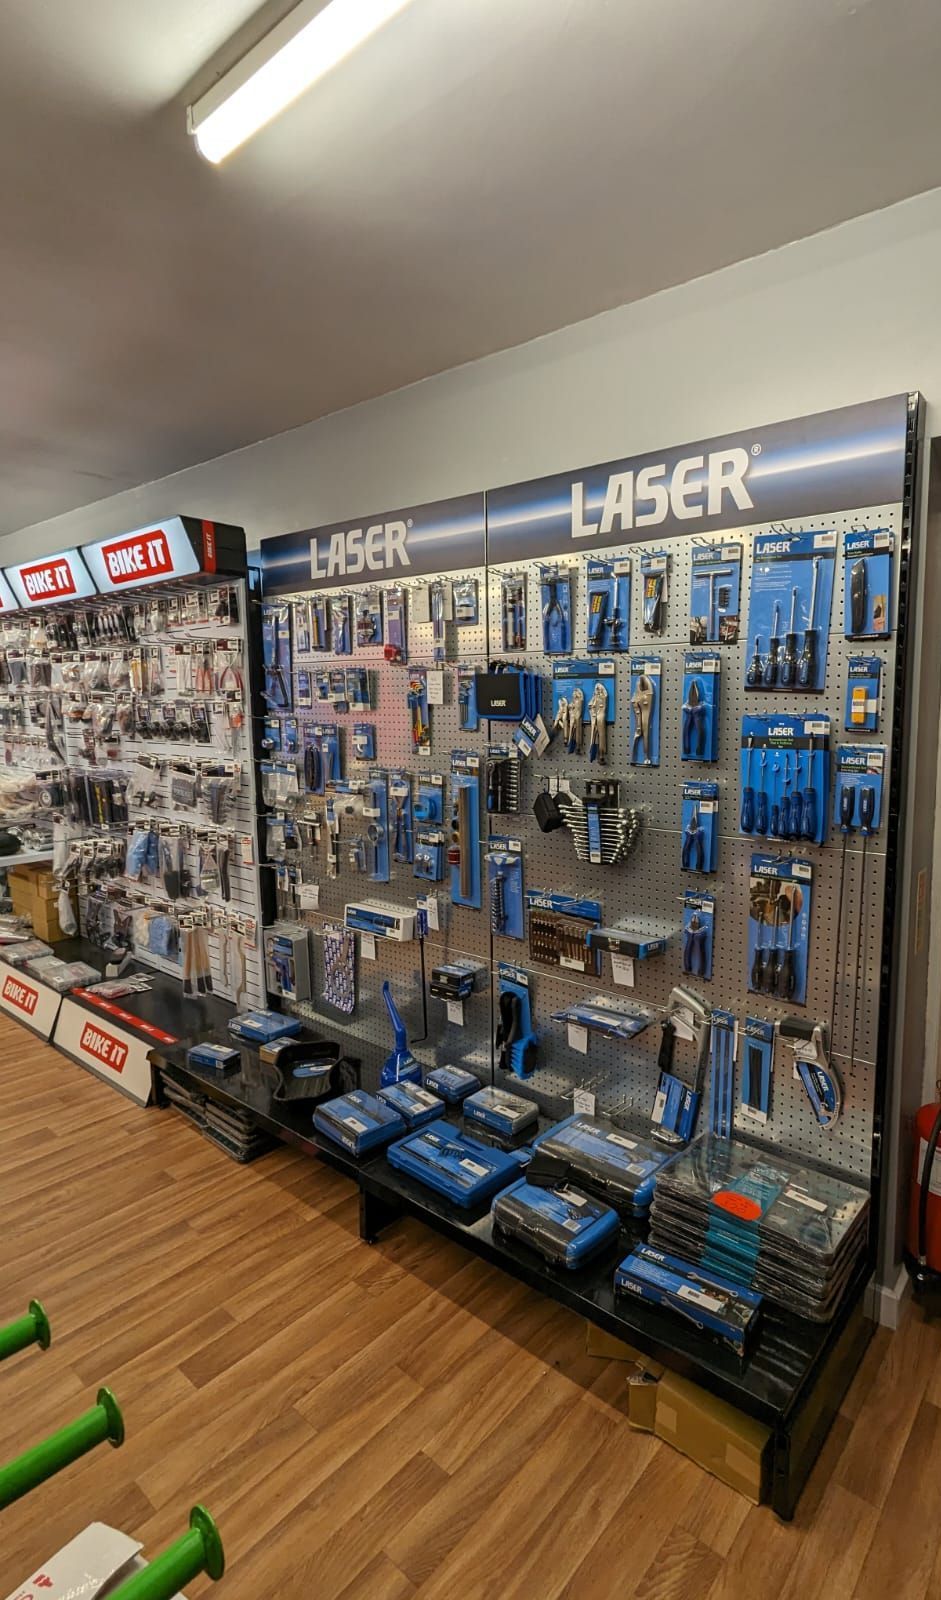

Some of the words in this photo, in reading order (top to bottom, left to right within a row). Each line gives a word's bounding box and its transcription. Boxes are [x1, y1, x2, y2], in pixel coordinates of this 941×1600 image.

[756, 541, 791, 554] LASER
[847, 540, 871, 550] LASER
[107, 544, 147, 577] BIKE
[146, 538, 166, 568] IT
[24, 569, 57, 595] BIKE
[54, 565, 70, 589] IT
[686, 661, 702, 669] LASER
[768, 727, 794, 736] LASER
[841, 756, 867, 765] LASER
[684, 788, 701, 796] LASER
[754, 864, 778, 876] LASER
[530, 898, 553, 909] LASER
[4, 981, 27, 1003] BIKE
[24, 992, 37, 1010] IT
[82, 1028, 112, 1058] BIKE
[110, 1044, 126, 1066] IT
[641, 1248, 665, 1261] LASER
[621, 1277, 642, 1294] LASER
